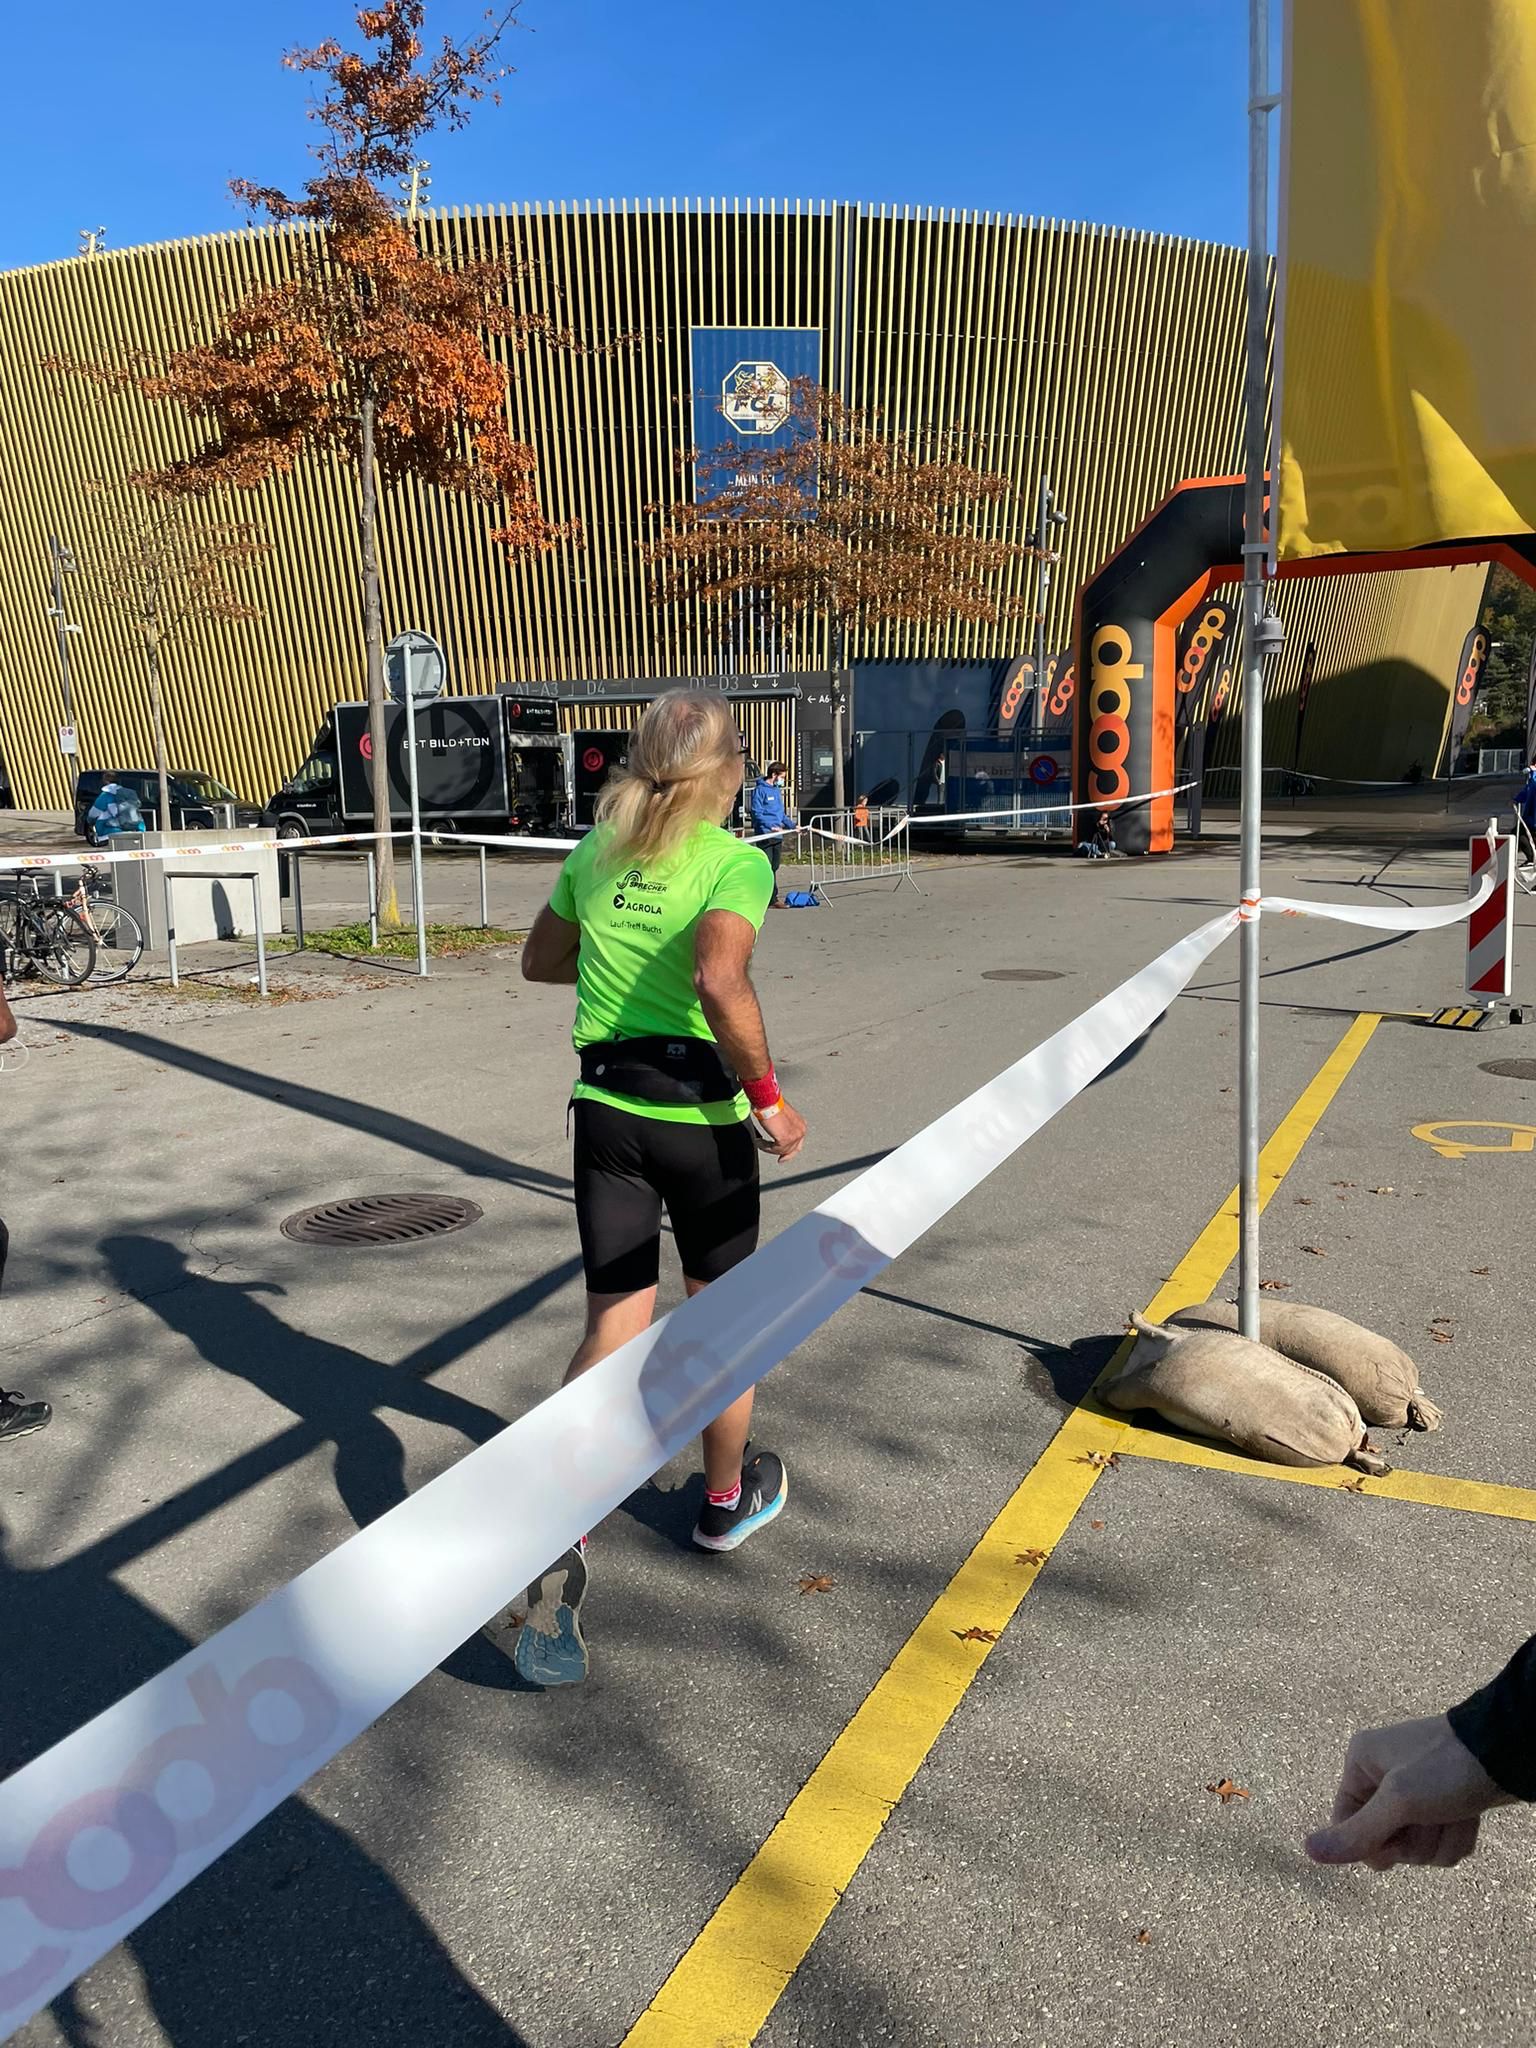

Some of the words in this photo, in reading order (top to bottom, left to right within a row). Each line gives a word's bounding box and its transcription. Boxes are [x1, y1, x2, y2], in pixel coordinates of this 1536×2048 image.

[1177, 608, 1226, 693] coop
[1456, 633, 1486, 705] coop
[515, 682, 559, 697] A1-A3
[587, 680, 606, 695] D4
[690, 676, 739, 691] D1-D3
[1212, 669, 1230, 721] coop
[1089, 624, 1144, 811] coop
[429, 737, 490, 749] BILD+TON
[629, 881, 667, 892] SPRECHER
[626, 902, 662, 914] AGROLA
[642, 923, 662, 934] Buchs
